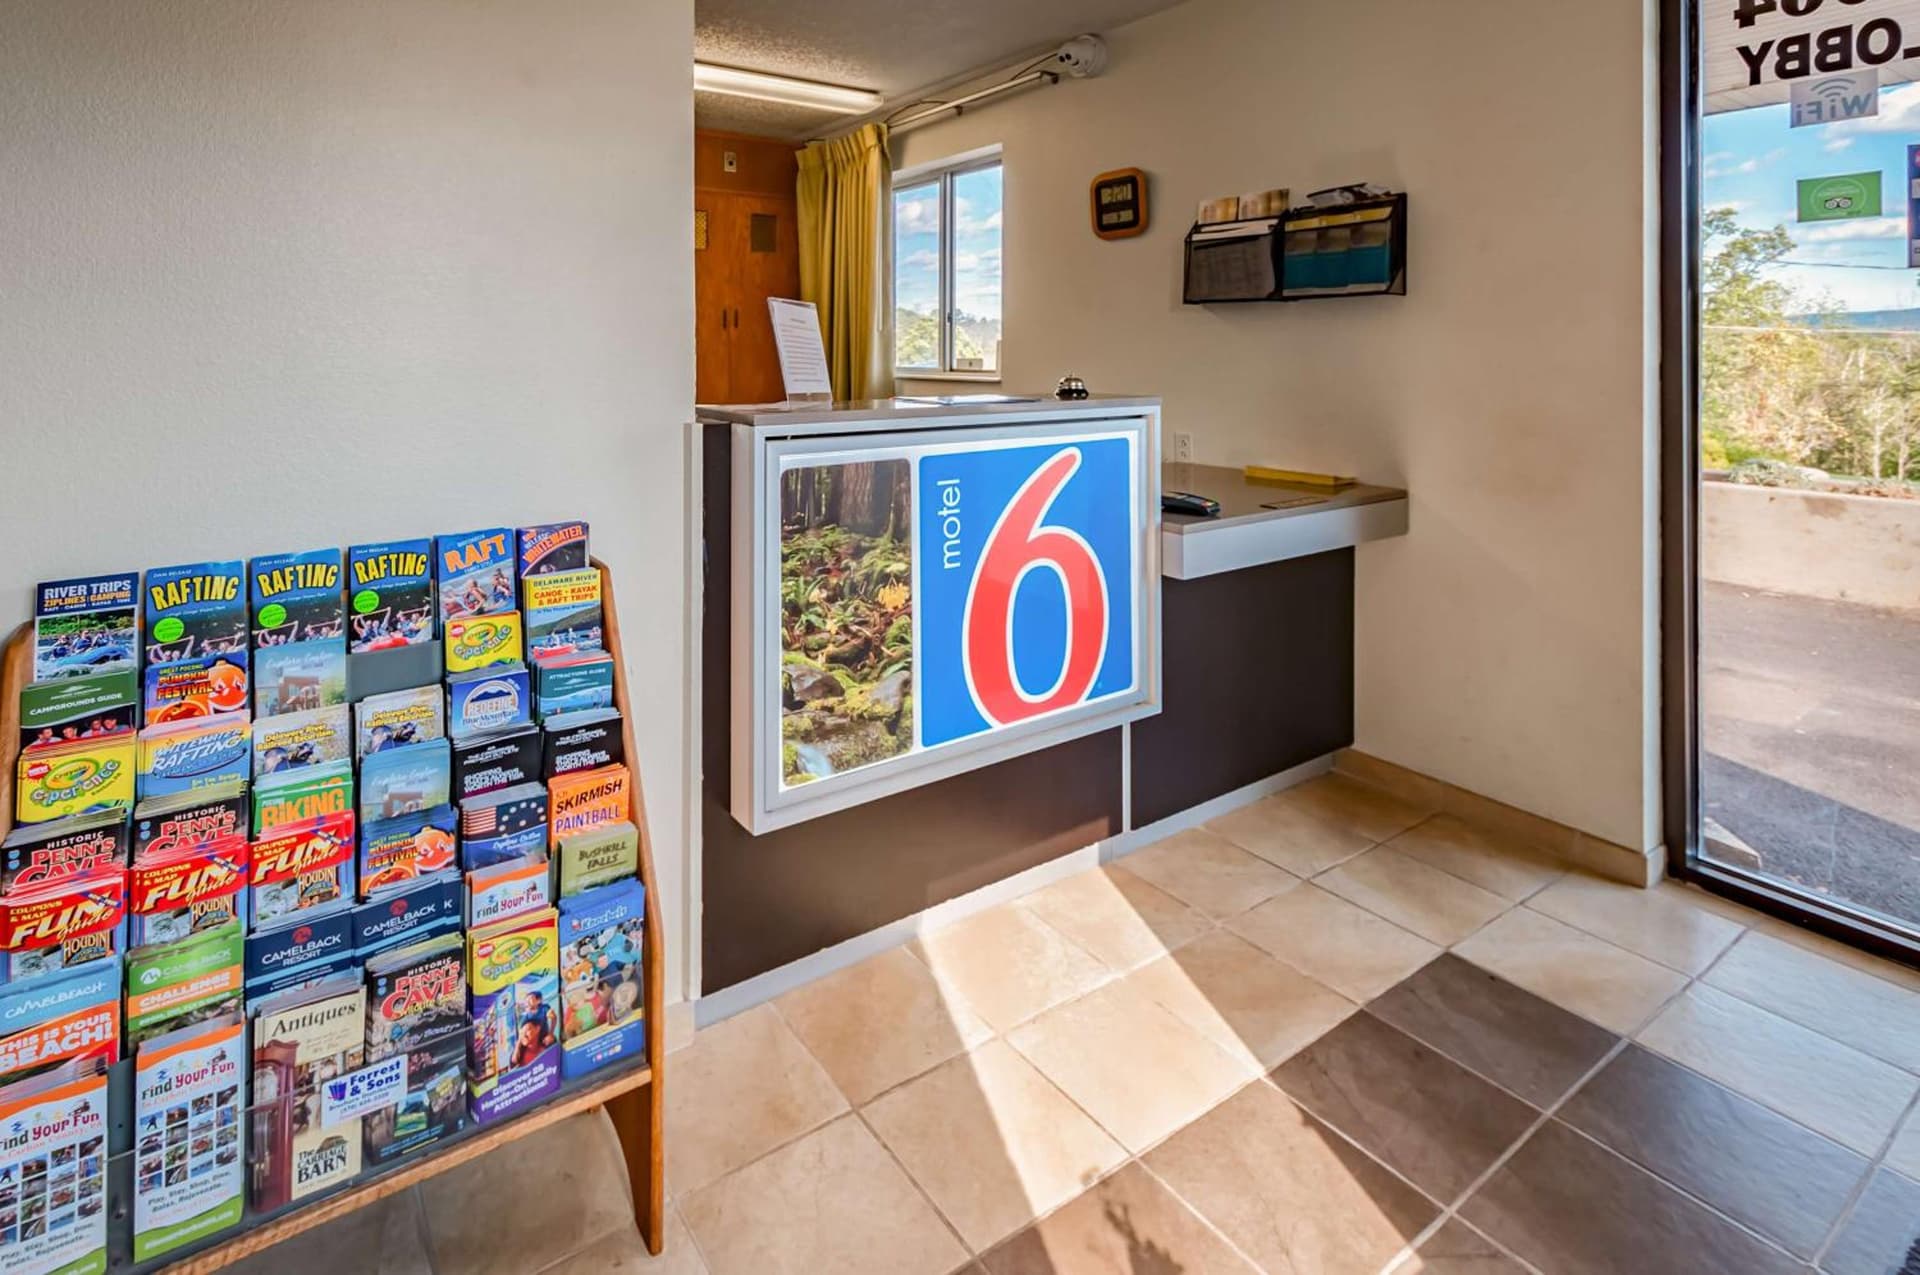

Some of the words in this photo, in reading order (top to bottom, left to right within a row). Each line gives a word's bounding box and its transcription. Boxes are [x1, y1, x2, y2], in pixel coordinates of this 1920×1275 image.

[937, 478, 961, 569] motel
[444, 533, 505, 573] RAFT
[523, 525, 583, 565] WHITEWATER
[257, 563, 338, 598] RAFTING
[354, 553, 427, 585] RAFTING
[533, 577, 573, 587] DELAWARE
[575, 574, 597, 583] RIVER
[43, 595, 86, 607] ZIPLINES
[44, 583, 88, 600] RIVER
[91, 580, 131, 594] TRIPS
[151, 576, 239, 612] RAFTING
[534, 589, 563, 599] CANOE
[570, 585, 598, 595] KAYAK
[546, 597, 568, 605] RAFT
[571, 593, 595, 602] TRIPS
[961, 446, 1110, 730] 6
[157, 681, 213, 700] FESTIVAL
[158, 670, 210, 686] PUMPKIN
[29, 696, 96, 716] CAMPGROUNDS
[97, 692, 123, 704] GUIDE
[151, 735, 242, 771] RAFTING
[261, 788, 345, 828] BIKING
[556, 779, 622, 814] SKIRMISH
[160, 810, 237, 838] PENN'S
[174, 805, 226, 821] HISTORIC
[555, 805, 620, 833] PAINTBALL
[32, 836, 116, 866] PENN'S
[47, 831, 104, 848] HISTORIC
[253, 837, 297, 851] COUPONS
[263, 847, 285, 857] MAP
[578, 841, 628, 861] BUSHKILL
[143, 863, 191, 878] COUPONS
[251, 829, 336, 884] FUN
[368, 846, 419, 870] FESTIVAL
[587, 854, 620, 870] FALLS
[140, 855, 234, 912] FUN
[154, 873, 178, 884] MAP
[298, 865, 337, 892] HOUDINI
[10, 900, 63, 915] COUPONS
[191, 895, 233, 923] HOUDINI
[501, 895, 524, 913] Your
[526, 891, 544, 903] Fun
[9, 890, 114, 948] FUN
[20, 911, 48, 922] MAP
[363, 904, 436, 937] CAMELBACK
[383, 919, 419, 937] RESORT
[64, 929, 111, 958] HOUDINI
[261, 933, 342, 965] CAMELBACK
[283, 949, 321, 966] RESORT
[394, 960, 461, 993] PENN'S
[407, 957, 452, 976] HISTORIC
[139, 972, 231, 1008] CHALLENGE
[381, 975, 459, 1021] CAVE
[43, 1028, 60, 1041] IS
[63, 1012, 112, 1033] YOUR
[271, 1001, 356, 1037] Antiques
[0, 1021, 113, 1073] BEACH!
[142, 1077, 172, 1100] Find
[175, 1068, 209, 1088] Your
[211, 1062, 235, 1076] Fun
[350, 1060, 400, 1085] Forrest
[350, 1085, 361, 1097] &
[367, 1072, 400, 1091] Sons
[481, 1083, 527, 1112] Hands-On
[527, 1065, 558, 1085] Family
[0, 1130, 28, 1151] ind
[32, 1119, 70, 1141] Your
[73, 1112, 100, 1127] Fun
[297, 1152, 347, 1184] BARN
